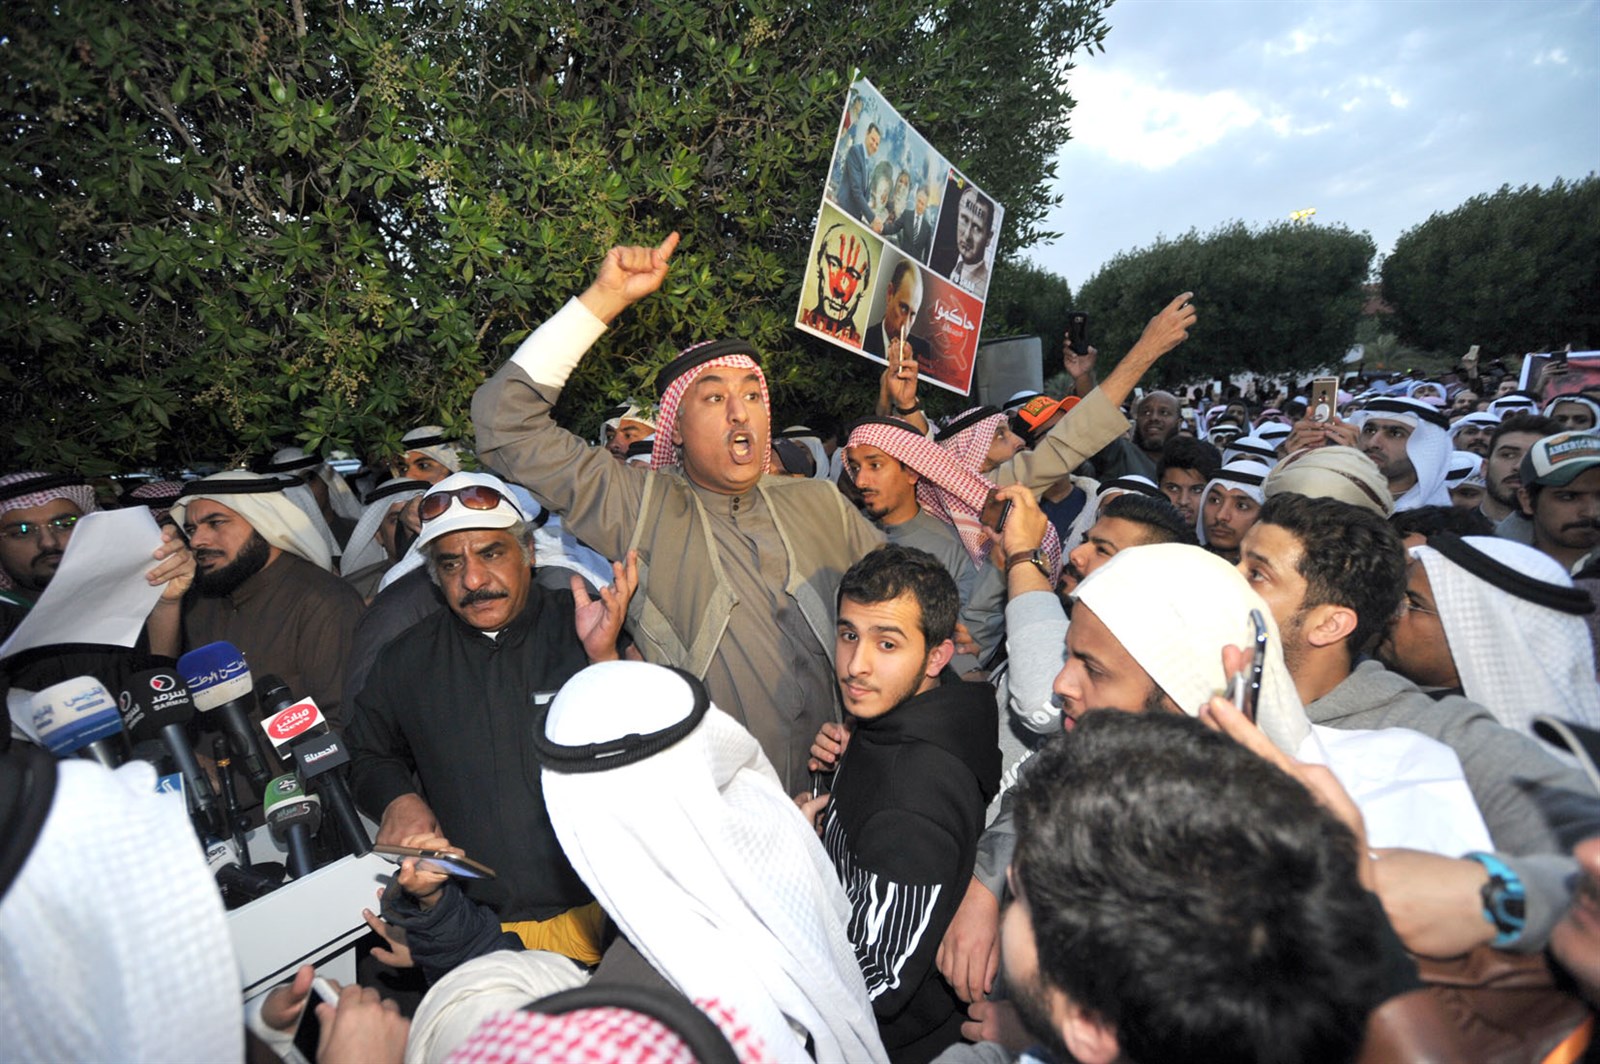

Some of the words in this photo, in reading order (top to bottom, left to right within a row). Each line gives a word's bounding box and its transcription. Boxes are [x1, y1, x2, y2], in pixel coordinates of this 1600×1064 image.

[801, 307, 861, 341] KILLER
[934, 298, 975, 331] حاكموا
[151, 689, 187, 704] سرمد
[153, 698, 189, 711] SARMAD
[276, 708, 310, 732] مباشر
[280, 716, 310, 735] News
[304, 743, 338, 763] الحصيلة
